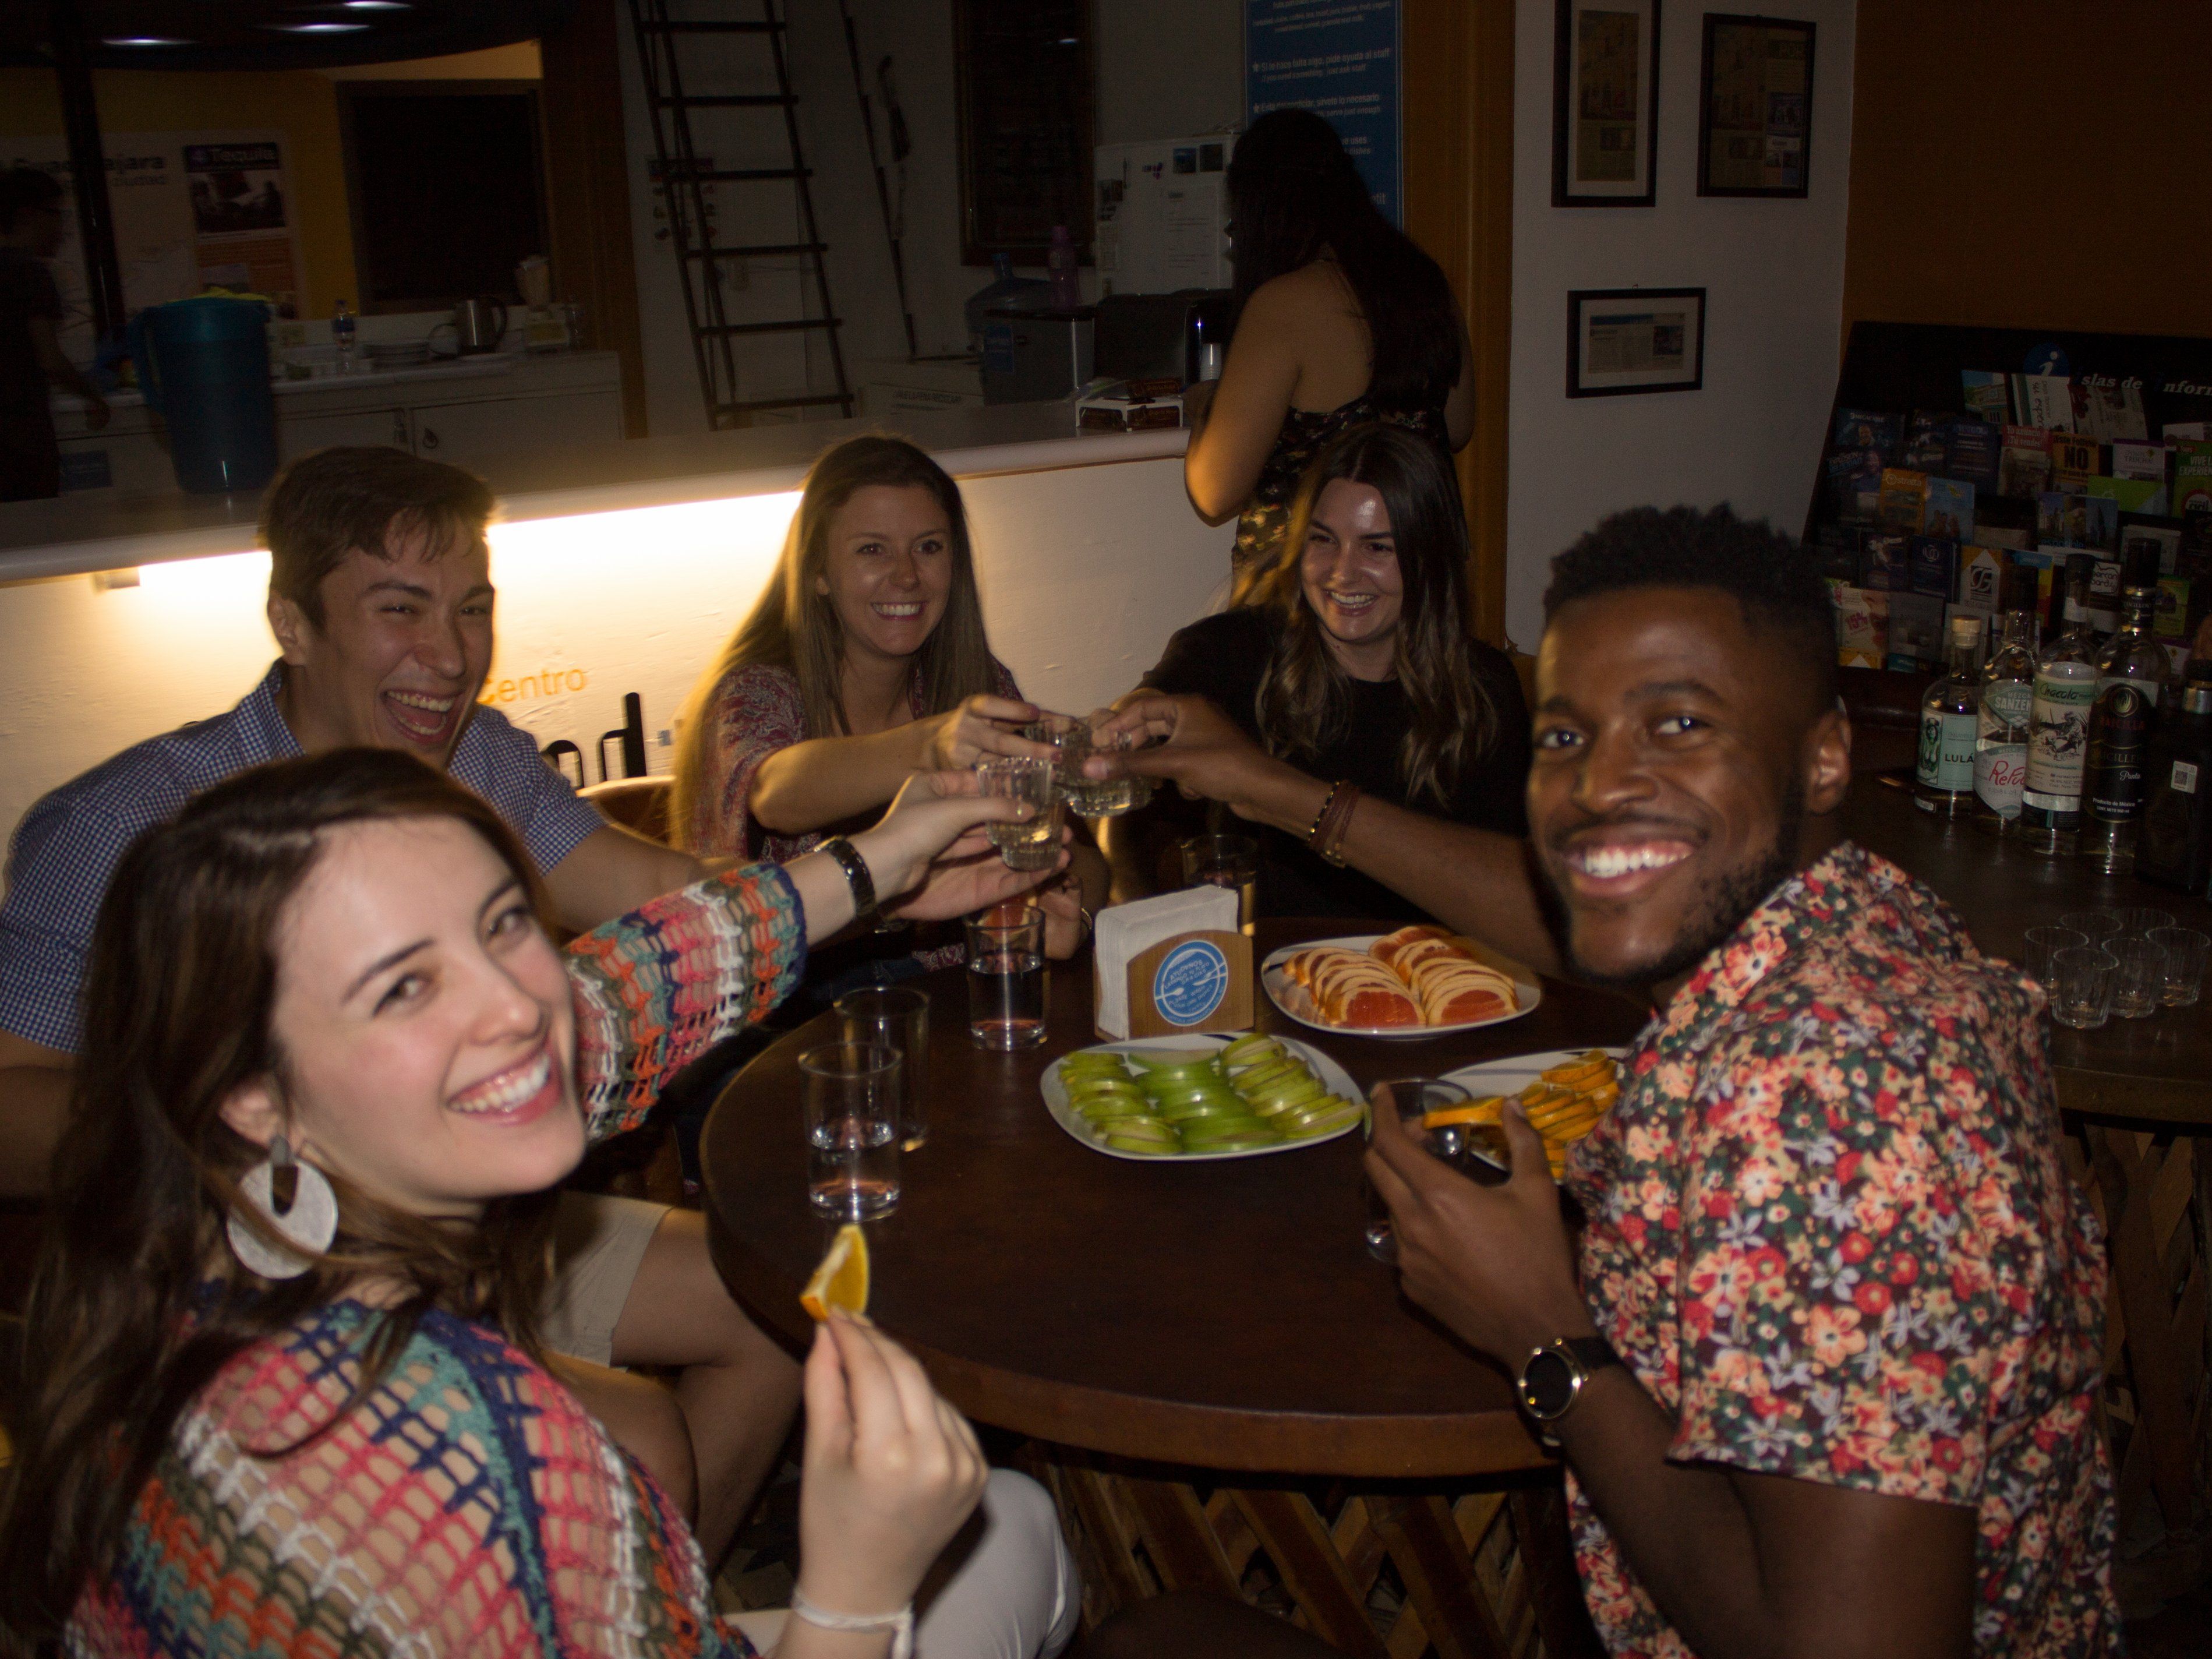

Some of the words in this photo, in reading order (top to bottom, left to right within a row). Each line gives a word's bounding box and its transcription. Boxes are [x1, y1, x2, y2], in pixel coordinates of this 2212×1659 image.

[1342, 51, 1363, 63] ayuda
[1365, 50, 1371, 59] al
[1373, 47, 1390, 58] staff
[1352, 63, 1366, 72] staff
[1347, 93, 1379, 104] necesario
[2121, 376, 2143, 390] de
[2063, 445, 2088, 470] NO
[2190, 456, 2207, 466] VIVE
[1945, 753, 1974, 763] LULÁ
